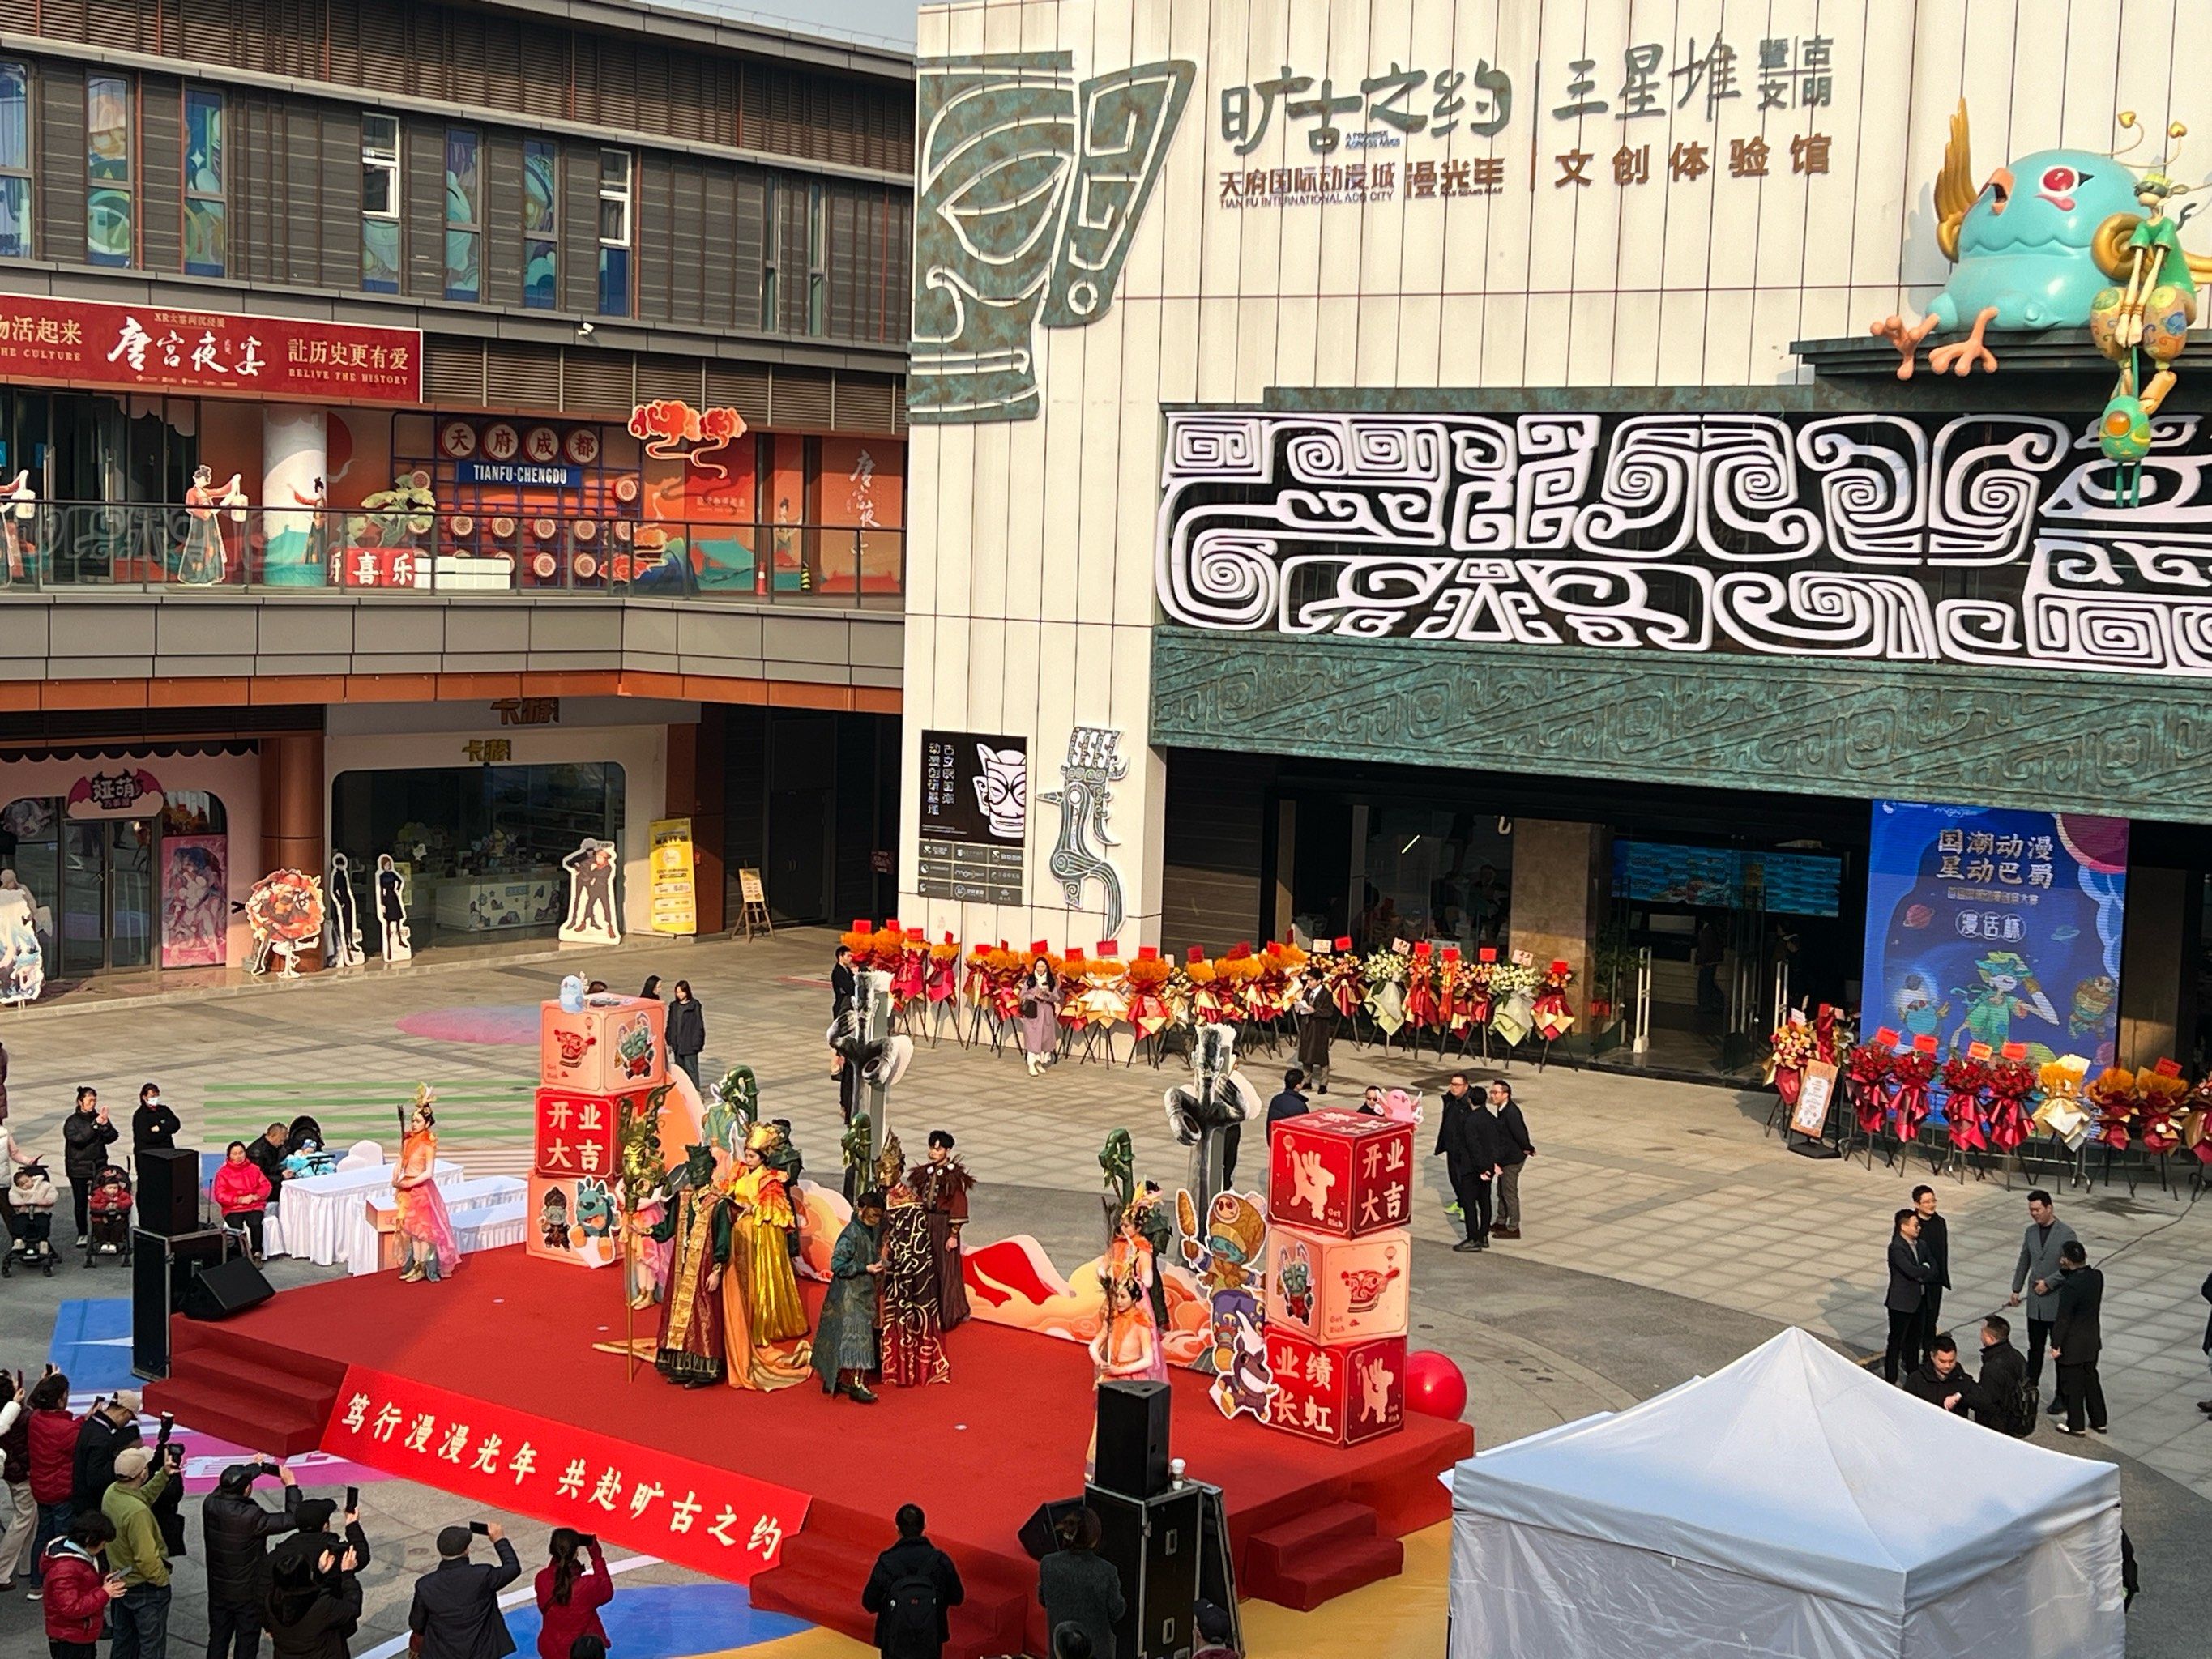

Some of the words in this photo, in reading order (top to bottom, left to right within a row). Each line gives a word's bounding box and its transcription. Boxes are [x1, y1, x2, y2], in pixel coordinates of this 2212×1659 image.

[1552, 32, 1742, 122] 三星堆
[1221, 58, 1512, 154] 旷古之约
[1219, 162, 1395, 196] 天府国际动漫城
[1406, 158, 1505, 199] 漫光年
[1555, 133, 1833, 187] 文创体验馆
[1220, 196, 1242, 210] TIAN
[1261, 192, 1343, 207] INTERNATIONAL
[1371, 191, 1394, 203] CITY
[23, 348, 81, 362] CULTURE
[106, 316, 267, 377] 唐宫夜宴
[288, 368, 330, 380] RELIVE
[335, 371, 357, 382] THE
[361, 373, 408, 385] HISTORY
[450, 428, 596, 458] 天府成都
[1937, 828, 2054, 861] 国潮动漫
[1936, 855, 2054, 889] 星动巴蜀
[546, 1102, 604, 1132] 开业
[545, 1139, 604, 1171] 大吉
[1362, 1138, 1406, 1179] 开业
[1360, 1181, 1406, 1227] 大吉
[1274, 1346, 1334, 1391] 业绩
[1273, 1390, 1334, 1435] 长虹
[341, 1392, 539, 1486] 笃行漫漫光年
[554, 1456, 784, 1562] 共赴旷古之约
